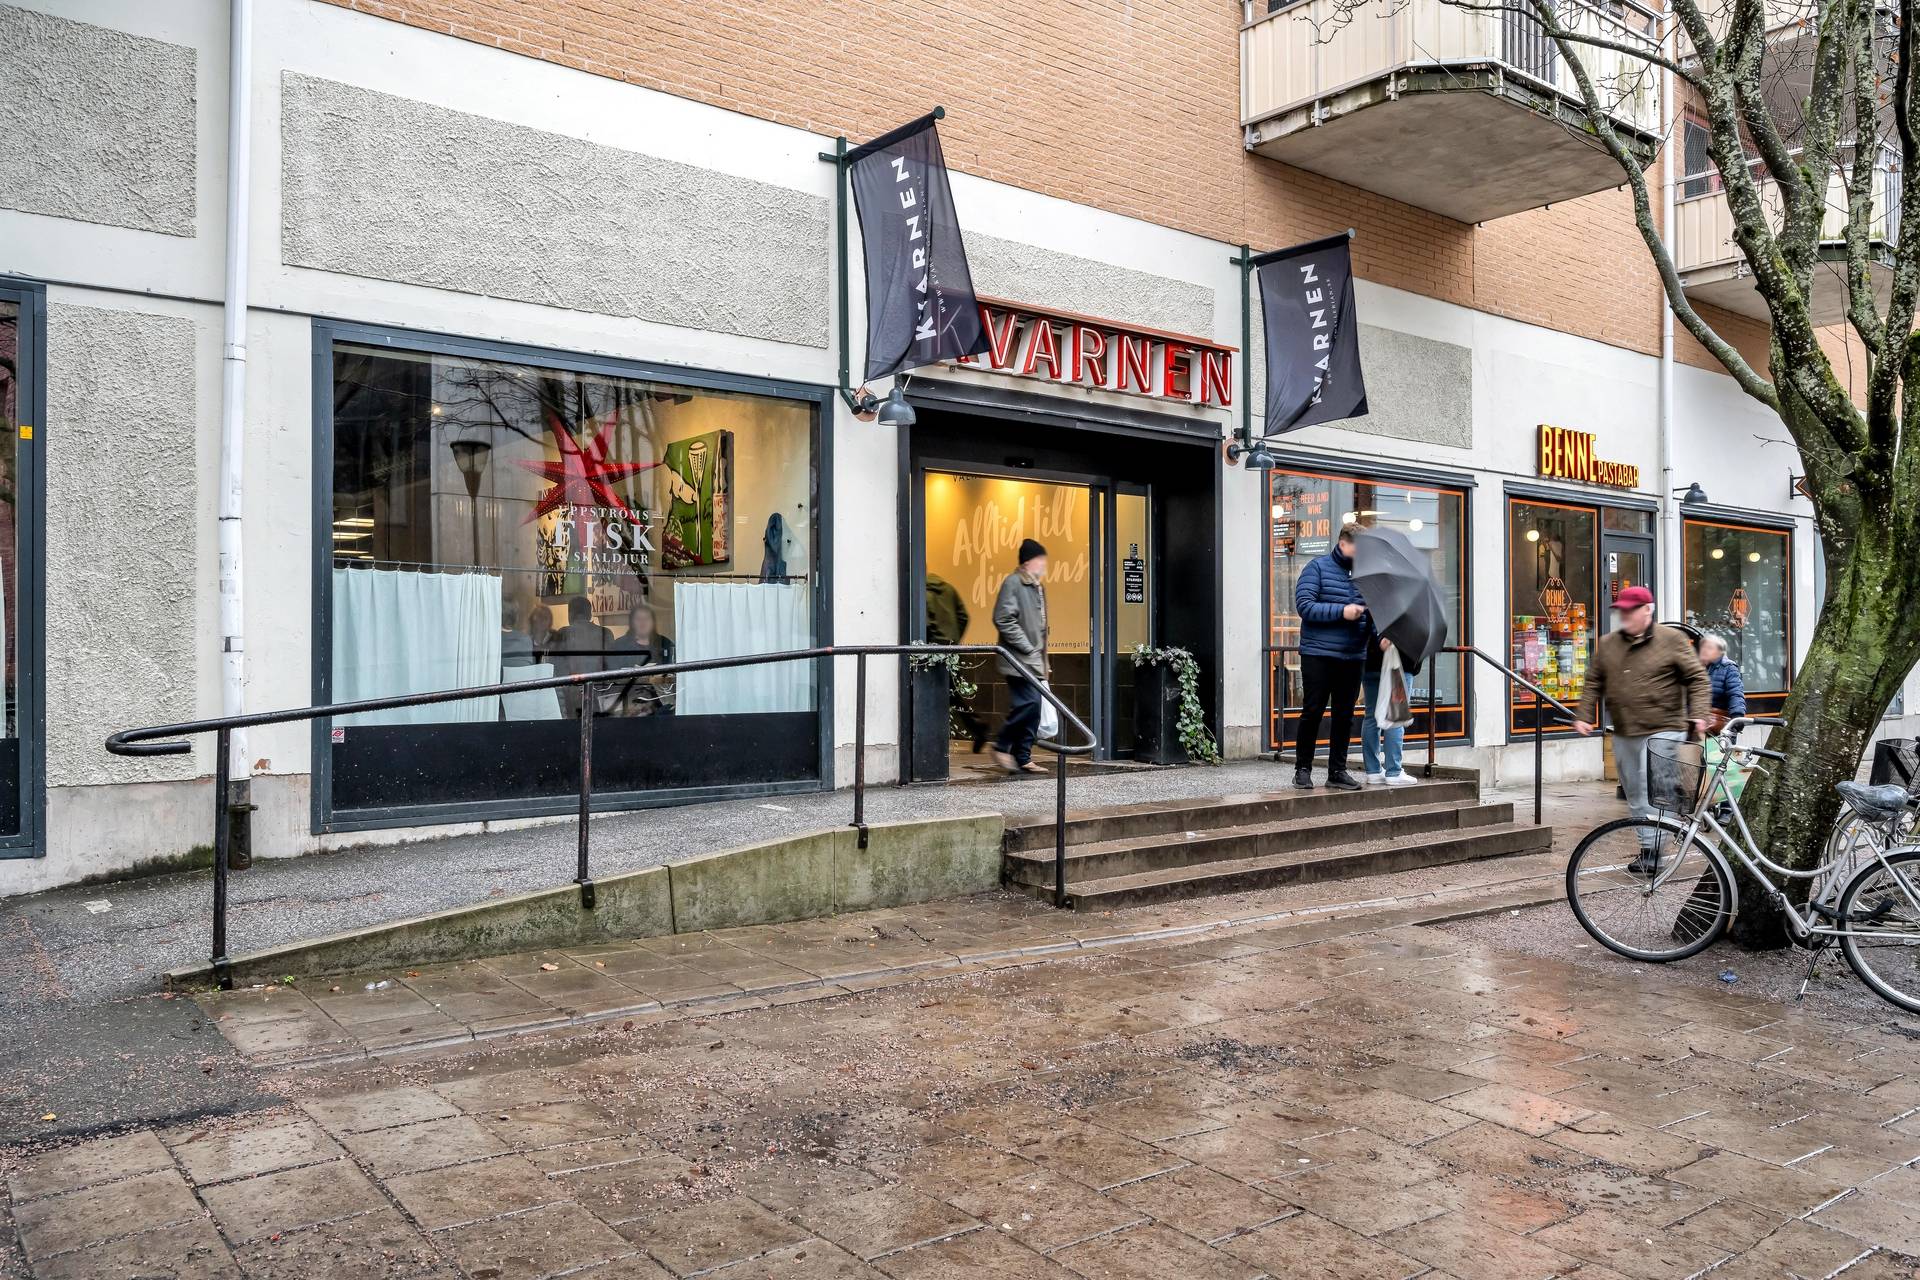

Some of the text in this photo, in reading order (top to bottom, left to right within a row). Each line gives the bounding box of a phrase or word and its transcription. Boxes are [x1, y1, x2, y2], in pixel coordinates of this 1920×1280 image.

[1540, 424, 1597, 482] BENNE
[1597, 460, 1640, 489] PASTABAR
[552, 520, 656, 551] FISK
[953, 486, 1077, 566] Alltid till
[1300, 520, 1313, 538] 30
[1316, 519, 1330, 537] KR
